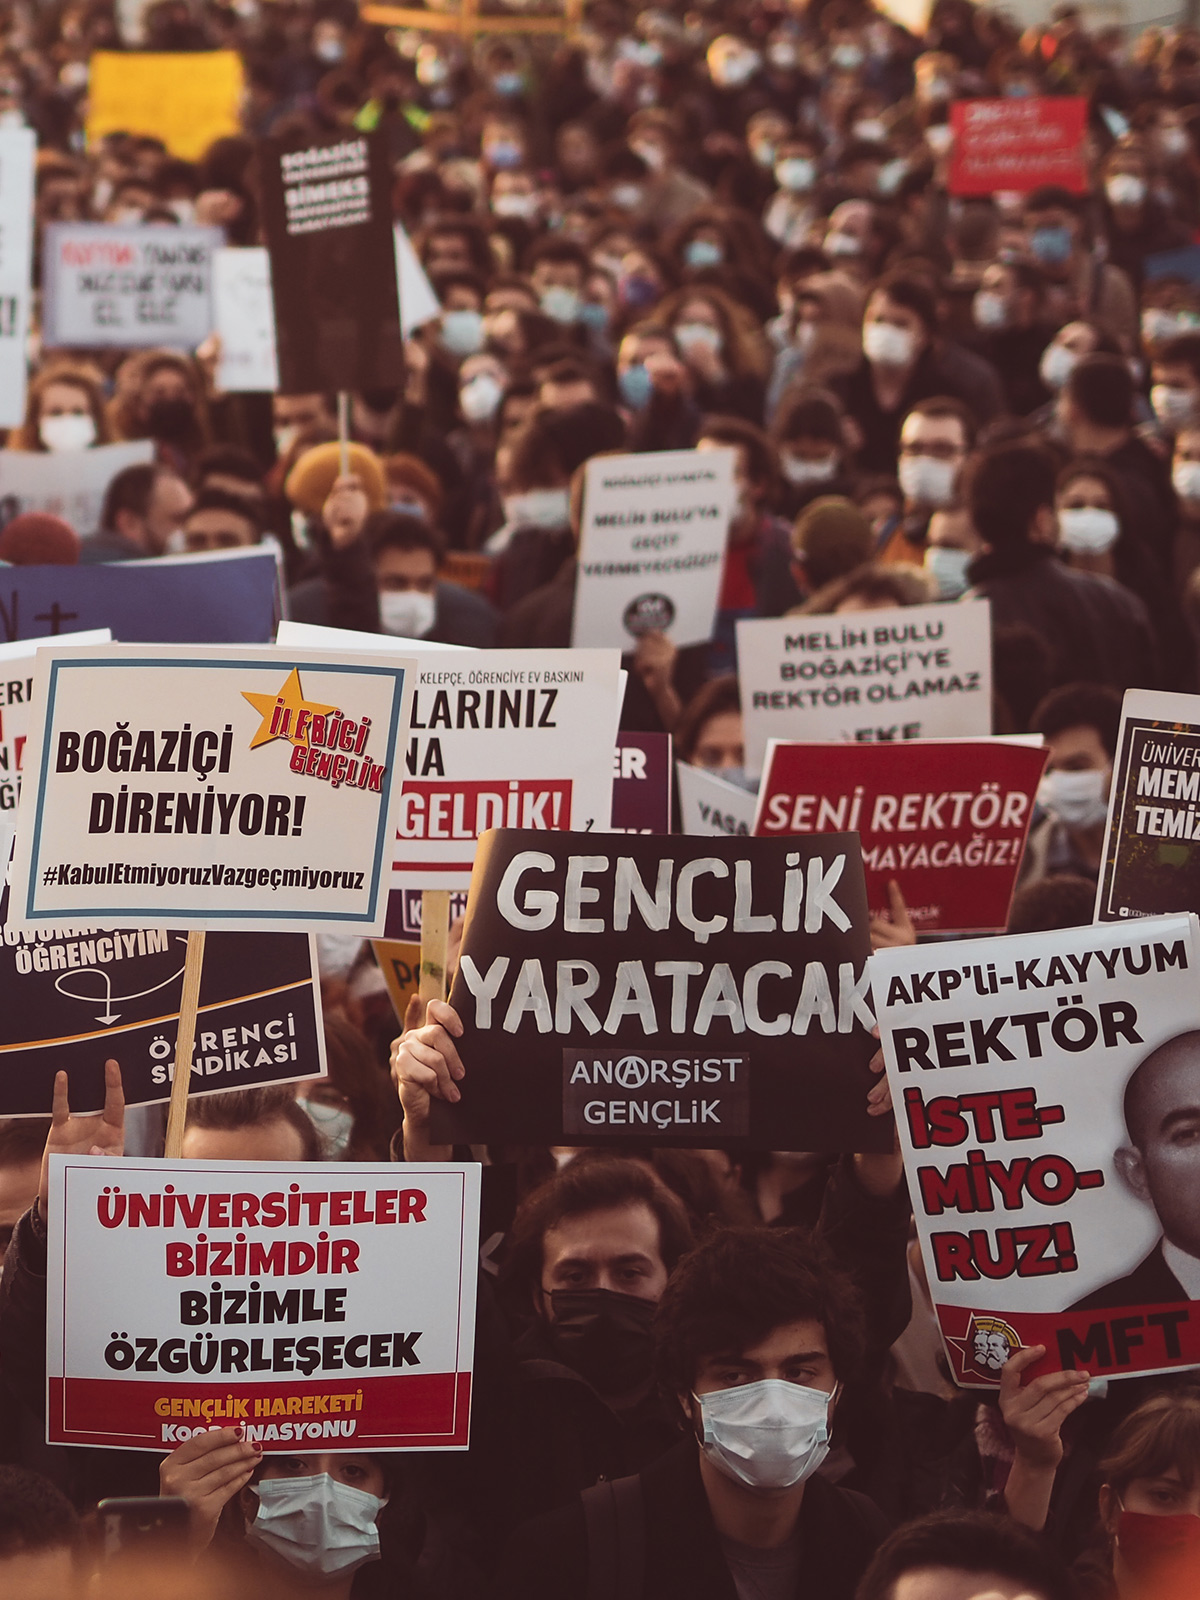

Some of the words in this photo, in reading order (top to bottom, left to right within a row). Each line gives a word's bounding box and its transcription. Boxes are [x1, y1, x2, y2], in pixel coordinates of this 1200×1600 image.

[785, 625, 866, 652] MELİH
[874, 621, 944, 646] BULU
[420, 673, 465, 687] KELEPÇE,
[468, 669, 524, 685] ÖĞRENCİYE
[528, 671, 541, 683] EV
[544, 671, 584, 683] BASKINI
[780, 648, 950, 682] BOĞAZİÇİ'YE
[753, 683, 860, 710] REKTÖR
[866, 672, 980, 704] OLAMAZ
[55, 722, 233, 782] BOĞAZİÇİ
[289, 745, 386, 791] GENÇLİK
[88, 784, 307, 837] DİRENİYOR!
[397, 781, 562, 839] GELDİK!
[764, 785, 864, 832] SENİ
[870, 782, 1028, 832] REKTÖR
[43, 862, 365, 891] #KabulEtmiyoruzVazgeçmiyoruz
[497, 850, 853, 944] GENÇLİK
[15, 930, 168, 974] ÖĞRENCİYİM
[886, 940, 1189, 1007] AKP'li-KAYYUM
[460, 955, 879, 1036] YARATACAK
[149, 1012, 296, 1059] ÖRENCİ
[892, 995, 1144, 1072] REKTÖR
[151, 1042, 297, 1084] SNDİKASI
[903, 1087, 1065, 1149] İSTE-
[97, 1183, 427, 1229] ÜNİVERSİTELER
[917, 1149, 1105, 1216] MİYO-
[165, 1231, 360, 1278] BİZİMDİR
[930, 1221, 1078, 1282] RUZ!
[180, 1281, 347, 1326] BİZİMLE
[104, 1332, 423, 1377] ÖZGÜRLEŞECEK
[1056, 1310, 1189, 1371] MFT
[154, 1395, 249, 1423] GENÇLİK
[255, 1389, 362, 1417] HAREKETİ
